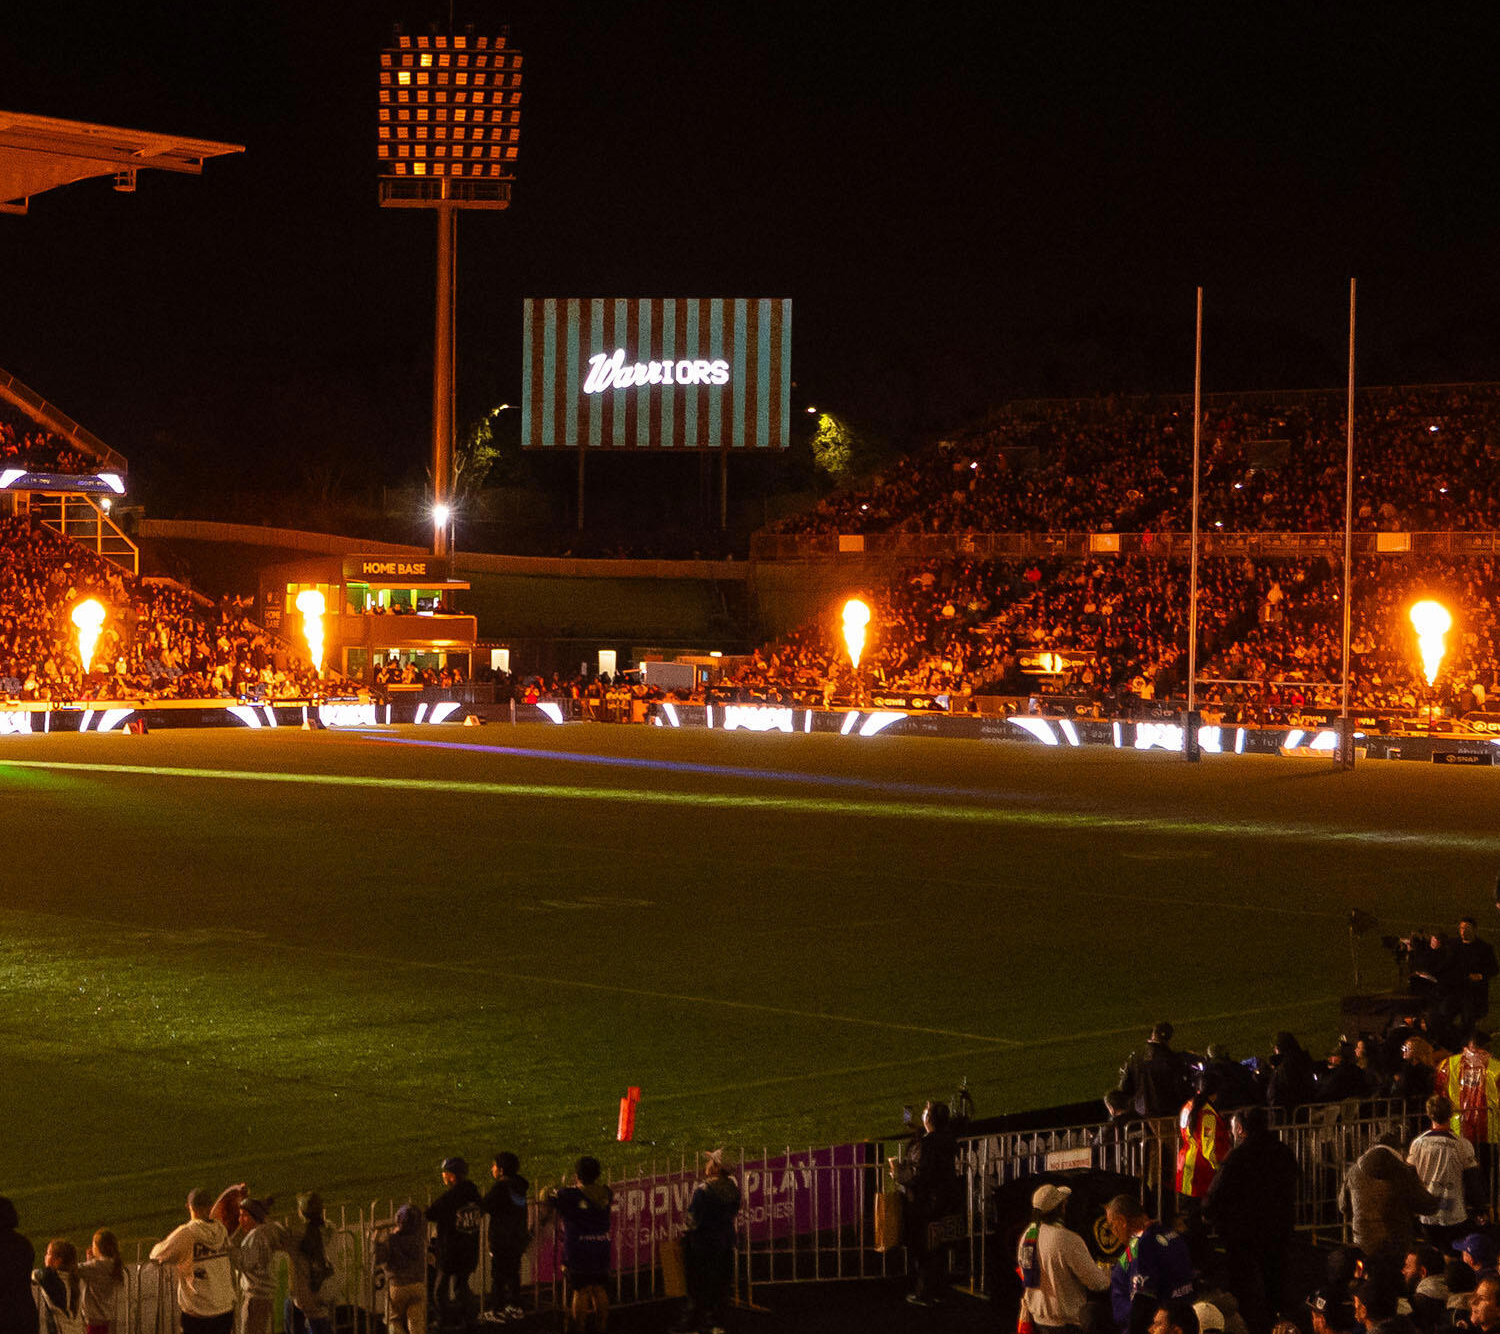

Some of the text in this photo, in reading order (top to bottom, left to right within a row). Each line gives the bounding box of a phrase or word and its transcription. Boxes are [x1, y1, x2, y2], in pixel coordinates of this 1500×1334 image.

[362, 562, 427, 575] HOME BASE
[884, 698, 906, 707] GWM
[1456, 755, 1480, 764] SNAP
